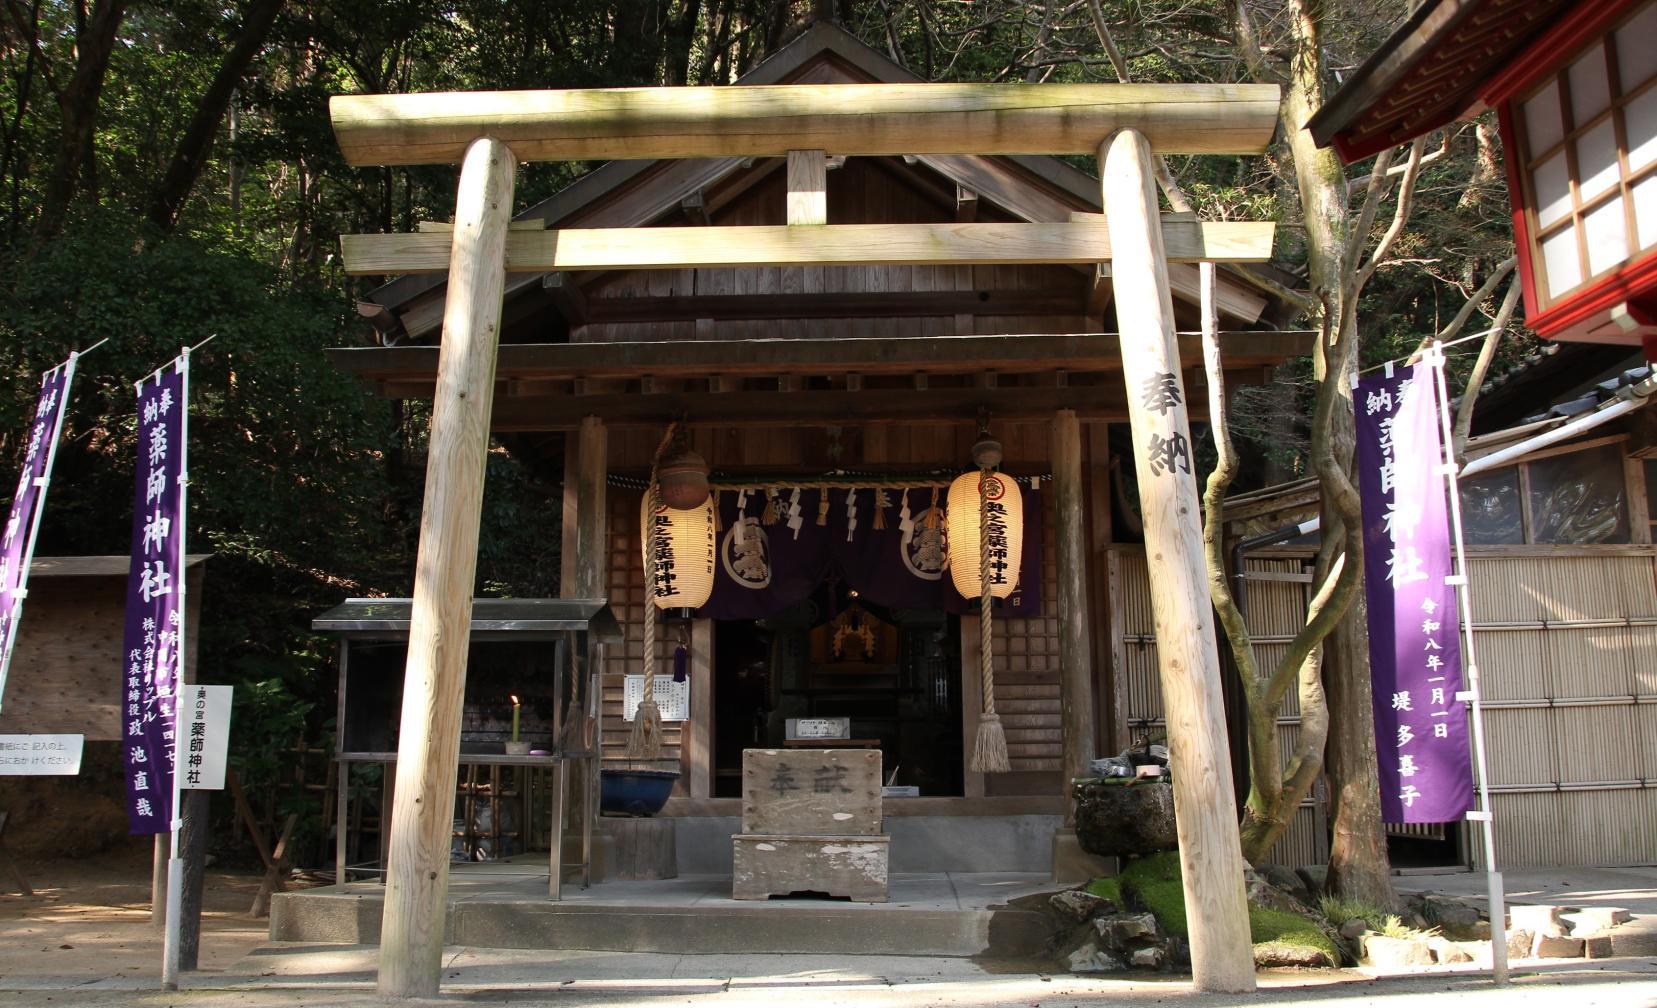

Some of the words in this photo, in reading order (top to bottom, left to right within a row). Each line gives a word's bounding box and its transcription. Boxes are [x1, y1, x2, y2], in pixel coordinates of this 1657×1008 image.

[143, 388, 174, 425] 奉納
[1141, 371, 1191, 477] 奉納
[138, 423, 172, 602] 薬師神社
[1421, 597, 1449, 738] 令和八年一月一日
[187, 722, 205, 784] 薬師神社
[1392, 691, 1421, 807] 堤多喜子
